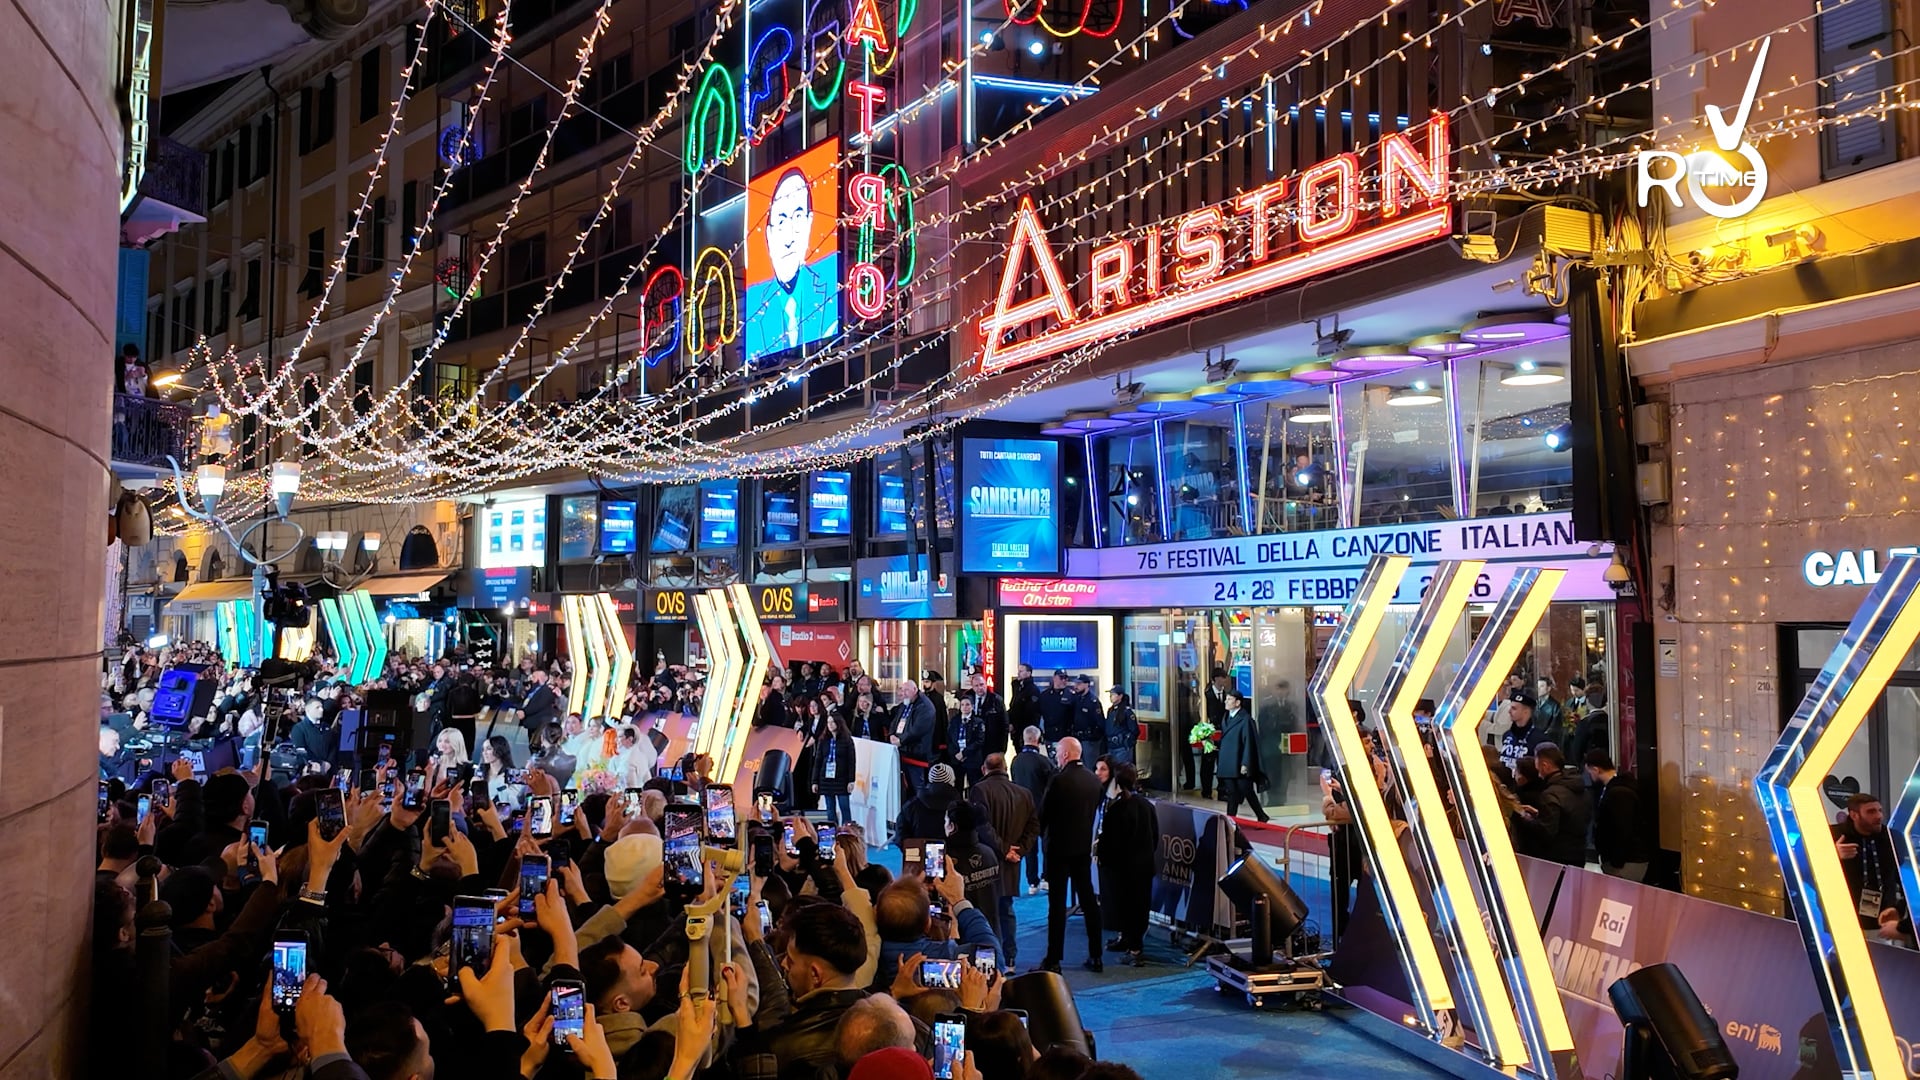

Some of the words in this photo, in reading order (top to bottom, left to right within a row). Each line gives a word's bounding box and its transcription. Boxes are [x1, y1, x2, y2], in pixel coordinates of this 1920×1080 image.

[978, 111, 1452, 373] ARISTON
[970, 486, 1040, 515] SANREMO
[1168, 545, 1246, 570] FESTIVAL
[1257, 538, 1320, 563] DELLA
[1332, 529, 1442, 558] CANZONE
[1461, 520, 1579, 550] ITALIAN
[1001, 578, 1041, 592] Teatro
[1044, 581, 1096, 593] Cinema
[656, 591, 686, 615] OVS
[762, 587, 793, 613] OVS
[791, 631, 809, 641] Radio
[809, 631, 814, 641] 2
[985, 616, 994, 688] CINEMA
[1162, 834, 1196, 864] 100
[970, 865, 1000, 881] SECURITY
[1599, 911, 1626, 934] Rai
[1726, 1020, 1758, 1043] eni
